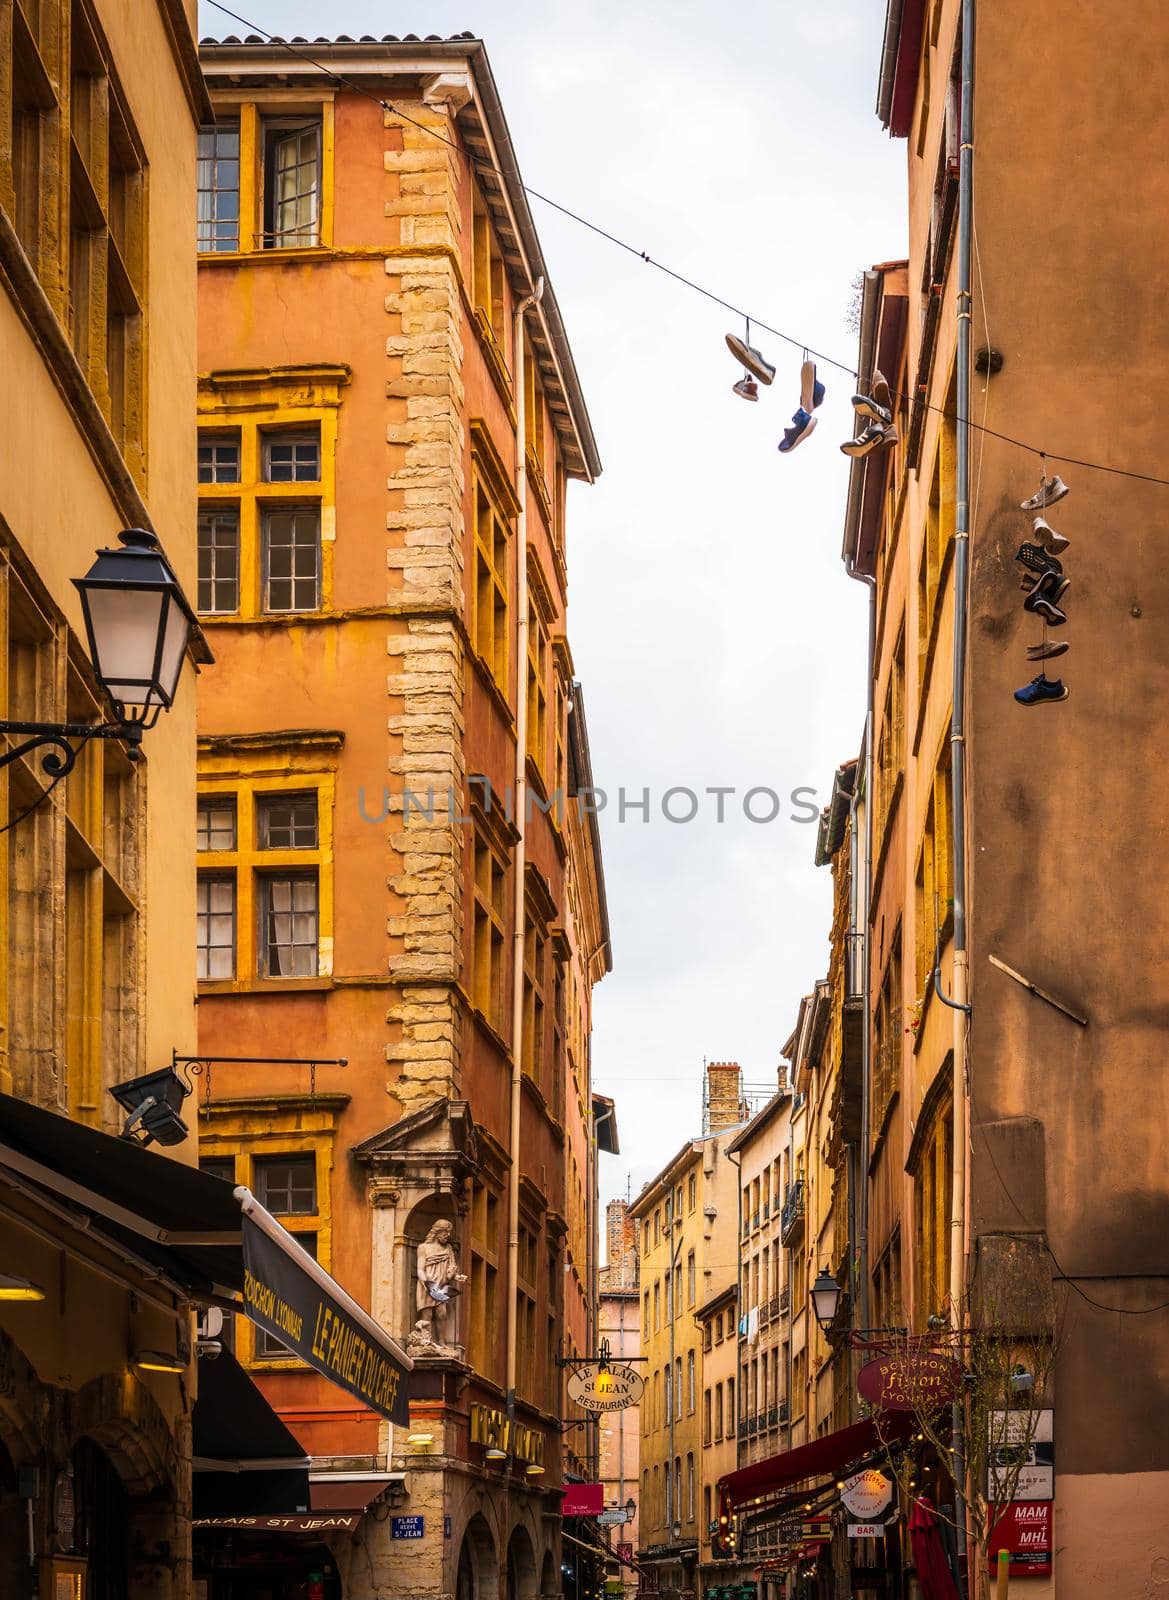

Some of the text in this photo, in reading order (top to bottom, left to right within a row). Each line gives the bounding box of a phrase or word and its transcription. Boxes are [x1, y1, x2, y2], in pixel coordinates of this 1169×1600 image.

[275, 1300, 303, 1343] LYONNAIS
[312, 1301, 400, 1412] LE PANIER DU CHEF
[577, 1367, 593, 1382] LE
[584, 1382, 629, 1394] St JEAN
[577, 1394, 634, 1410] RESTAURANT
[1015, 1506, 1048, 1518] MAM
[267, 1518, 294, 1527] ST
[300, 1517, 352, 1529] JEAN
[857, 1526, 875, 1534] BAR
[1020, 1532, 1048, 1543] MHL
